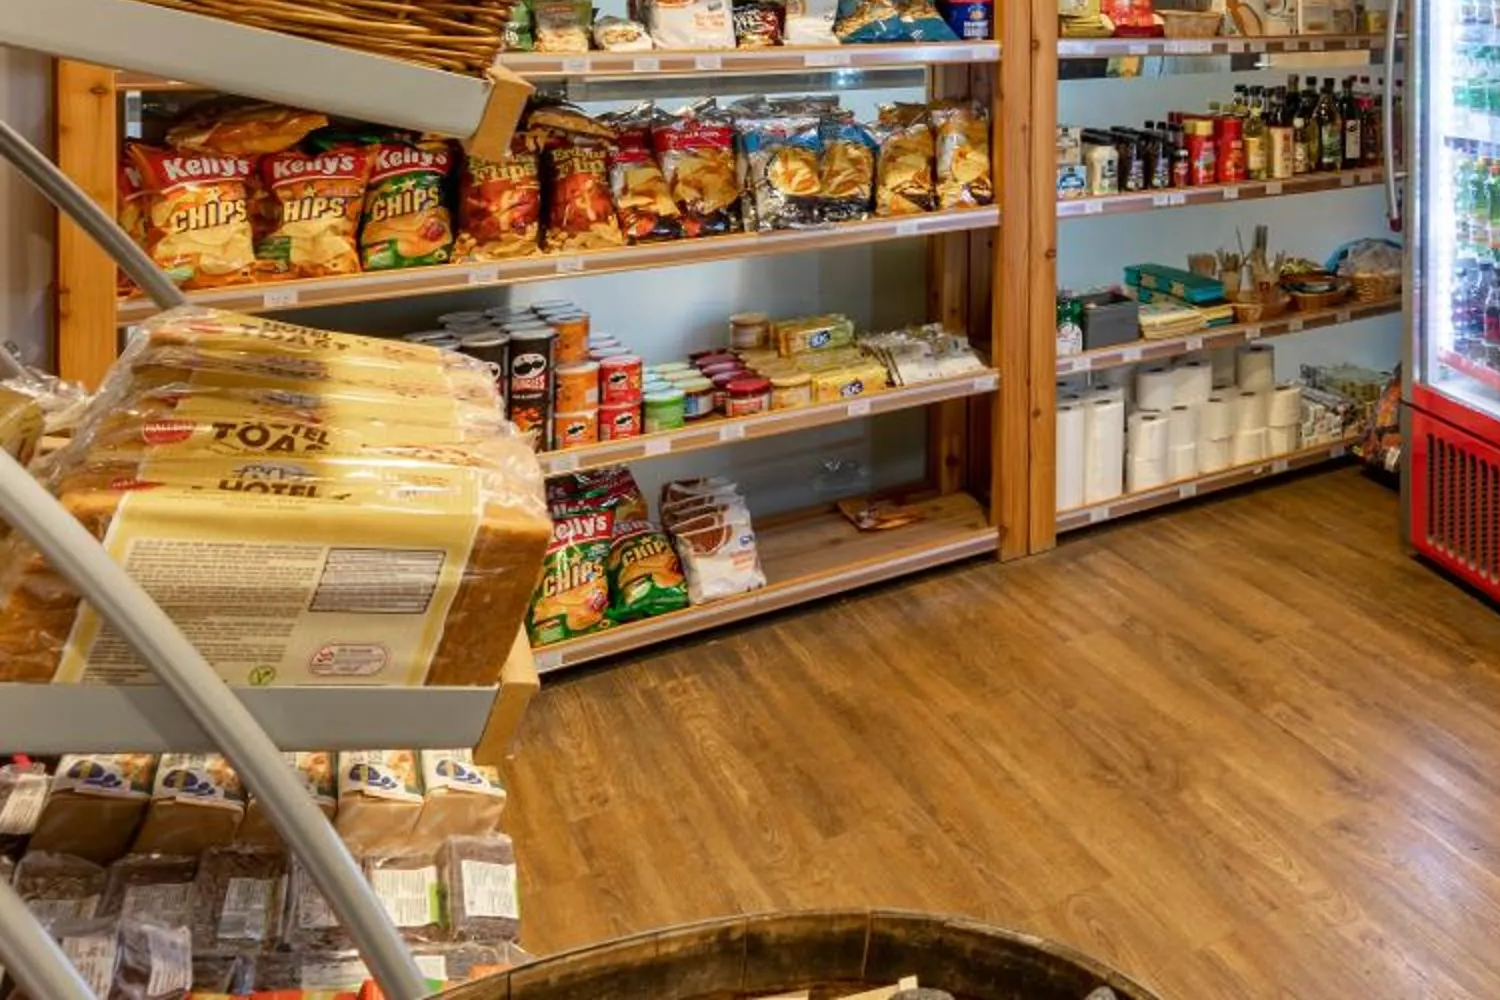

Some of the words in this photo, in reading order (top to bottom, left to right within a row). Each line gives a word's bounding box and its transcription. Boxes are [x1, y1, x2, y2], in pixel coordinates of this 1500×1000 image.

[163, 155, 251, 179] Kelly's
[273, 155, 355, 179] Kelly's
[374, 147, 448, 171] Kelly's
[171, 199, 249, 233] CHIPS
[283, 197, 346, 223] HIPS
[370, 186, 440, 221] CHIPS
[556, 513, 608, 541] elly's
